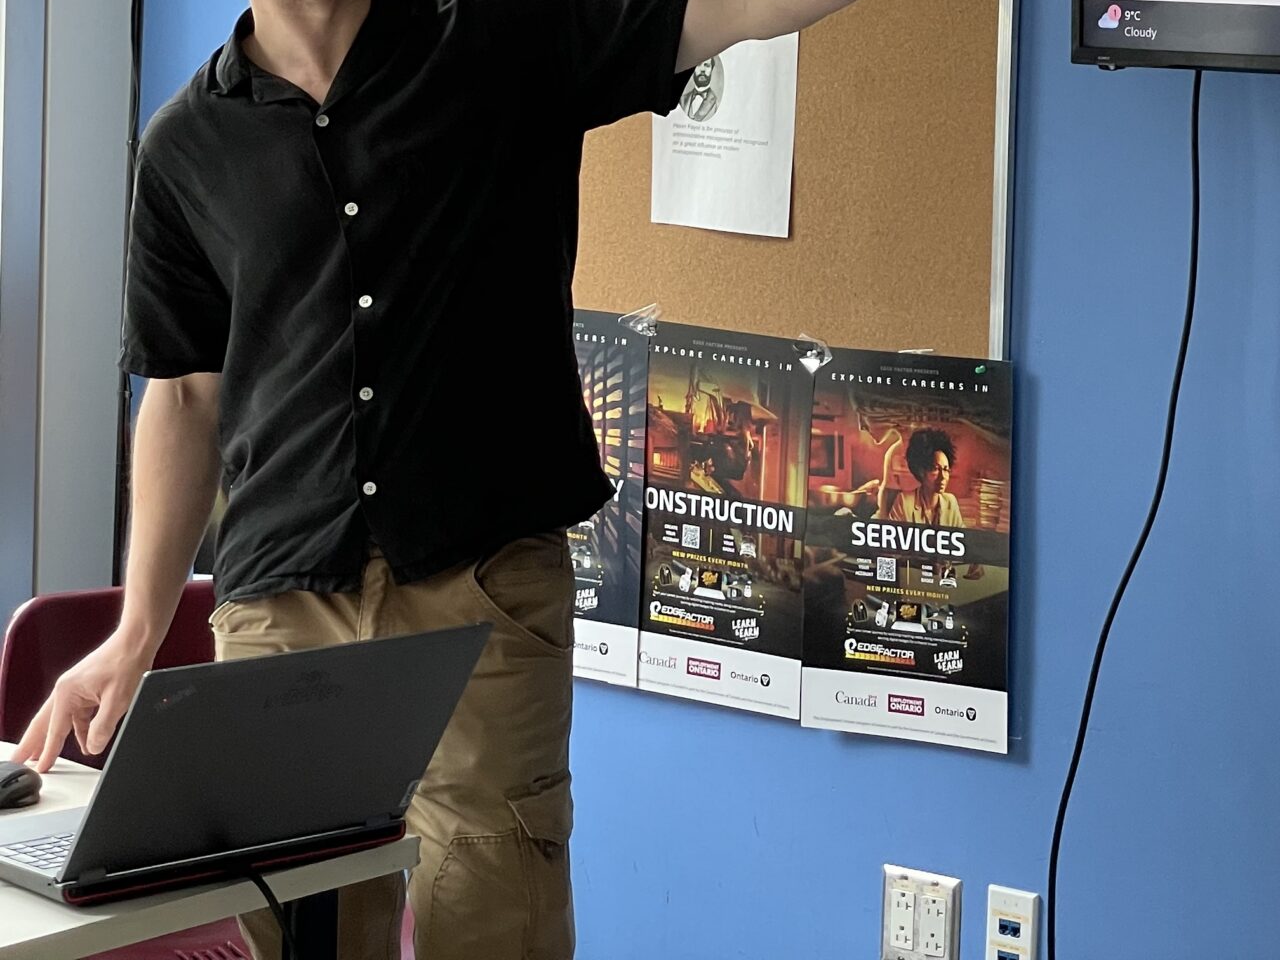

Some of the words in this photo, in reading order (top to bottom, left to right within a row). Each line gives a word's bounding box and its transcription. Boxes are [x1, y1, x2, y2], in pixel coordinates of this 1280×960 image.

[1124, 10, 1141, 21] 9°C
[1124, 27, 1158, 41] Cloudy
[576, 333, 606, 344] EERS
[614, 337, 627, 346] IN
[712, 353, 770, 368] CAREERS
[779, 362, 792, 371] IN
[831, 372, 891, 385] EXPLORE
[902, 378, 964, 390] CAREERS
[975, 384, 988, 393] IN
[645, 486, 794, 533] ONSTRUCTION
[851, 521, 966, 557] SERVICES
[672, 550, 686, 558] NEW
[686, 552, 707, 562] PRIZES
[707, 556, 726, 565] EVERY
[727, 559, 748, 569] MONTH
[576, 587, 595, 599] EARN
[882, 586, 904, 595] PRIZES
[905, 589, 925, 597] EVERY
[926, 592, 949, 600] MONTH
[731, 617, 757, 630] LEARN
[639, 650, 677, 670] Canada
[933, 650, 960, 663] LEARN
[688, 665, 719, 678] ONTARIO
[730, 671, 759, 684] Ontario
[835, 690, 878, 708] Canada
[889, 703, 923, 713] ONTARIO
[934, 706, 965, 717] Ontario
